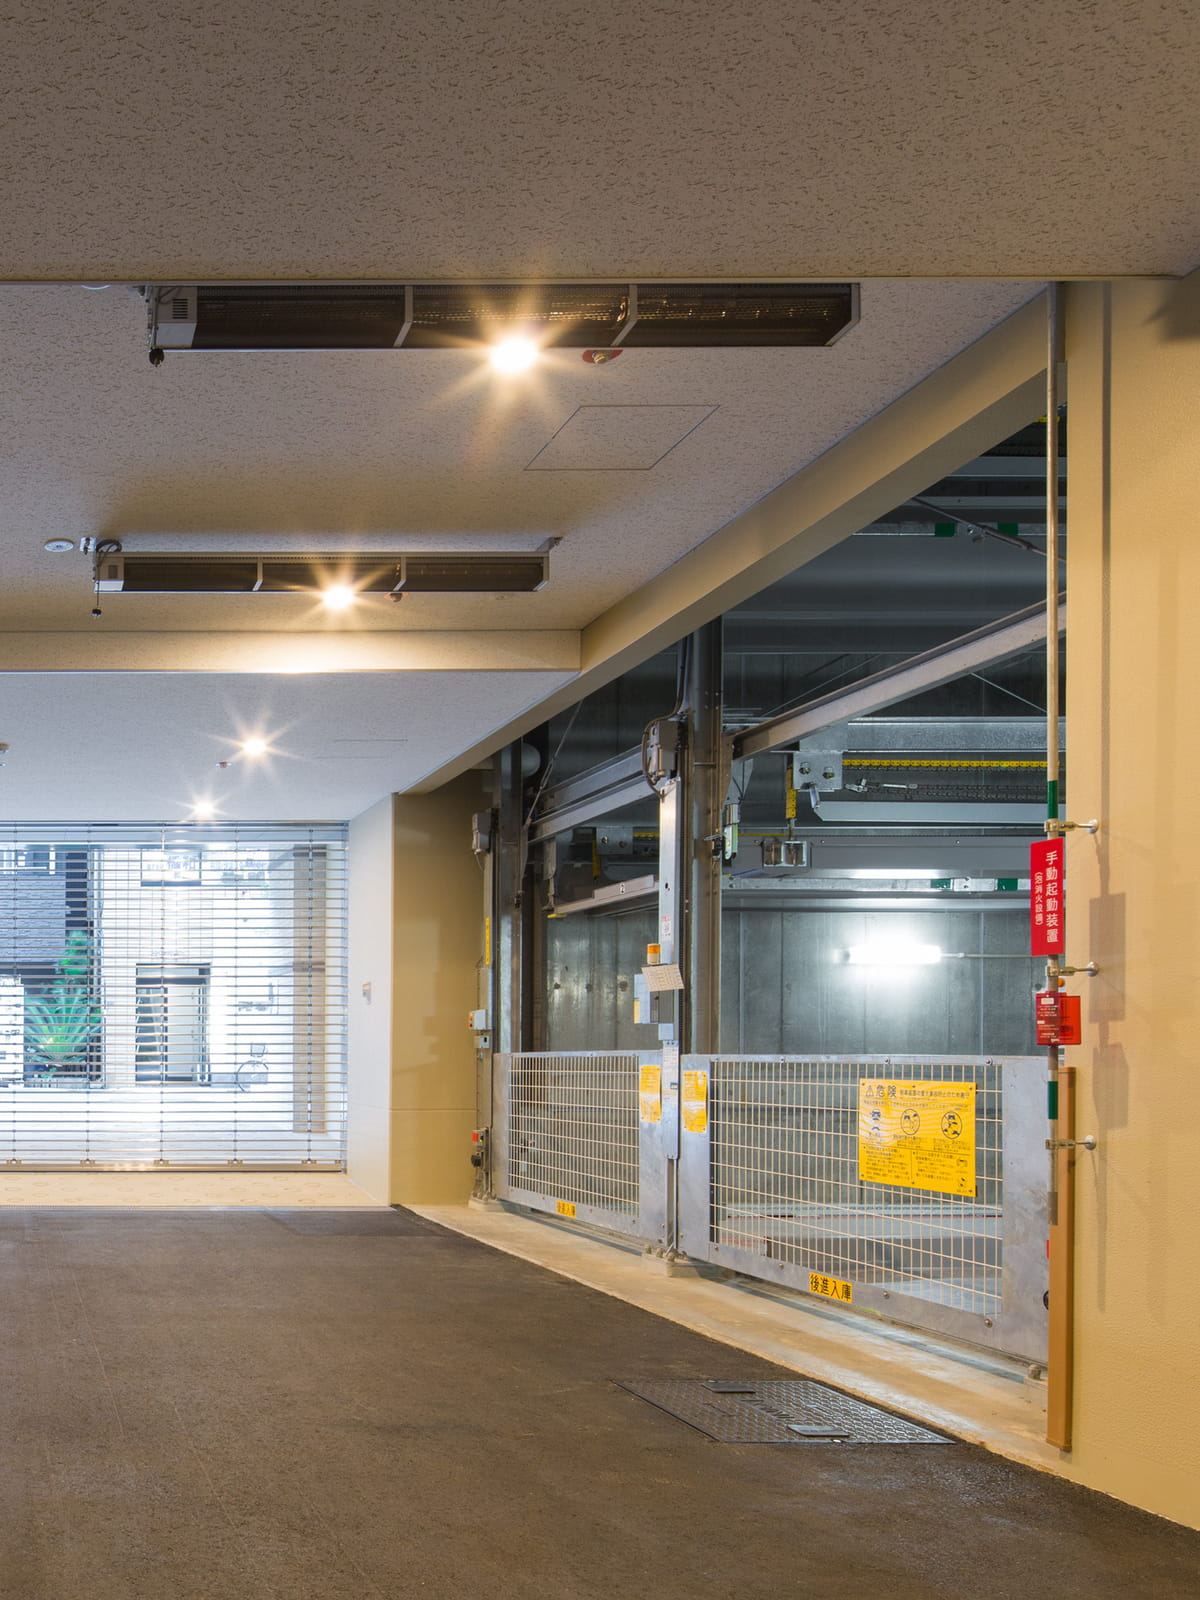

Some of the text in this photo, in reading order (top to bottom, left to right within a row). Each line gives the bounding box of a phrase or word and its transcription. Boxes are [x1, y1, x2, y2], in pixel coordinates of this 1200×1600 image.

[1045, 850, 1059, 943] 手動起動装置
[876, 1084, 897, 1098] 危険
[810, 1273, 851, 1301] 後進入庫
